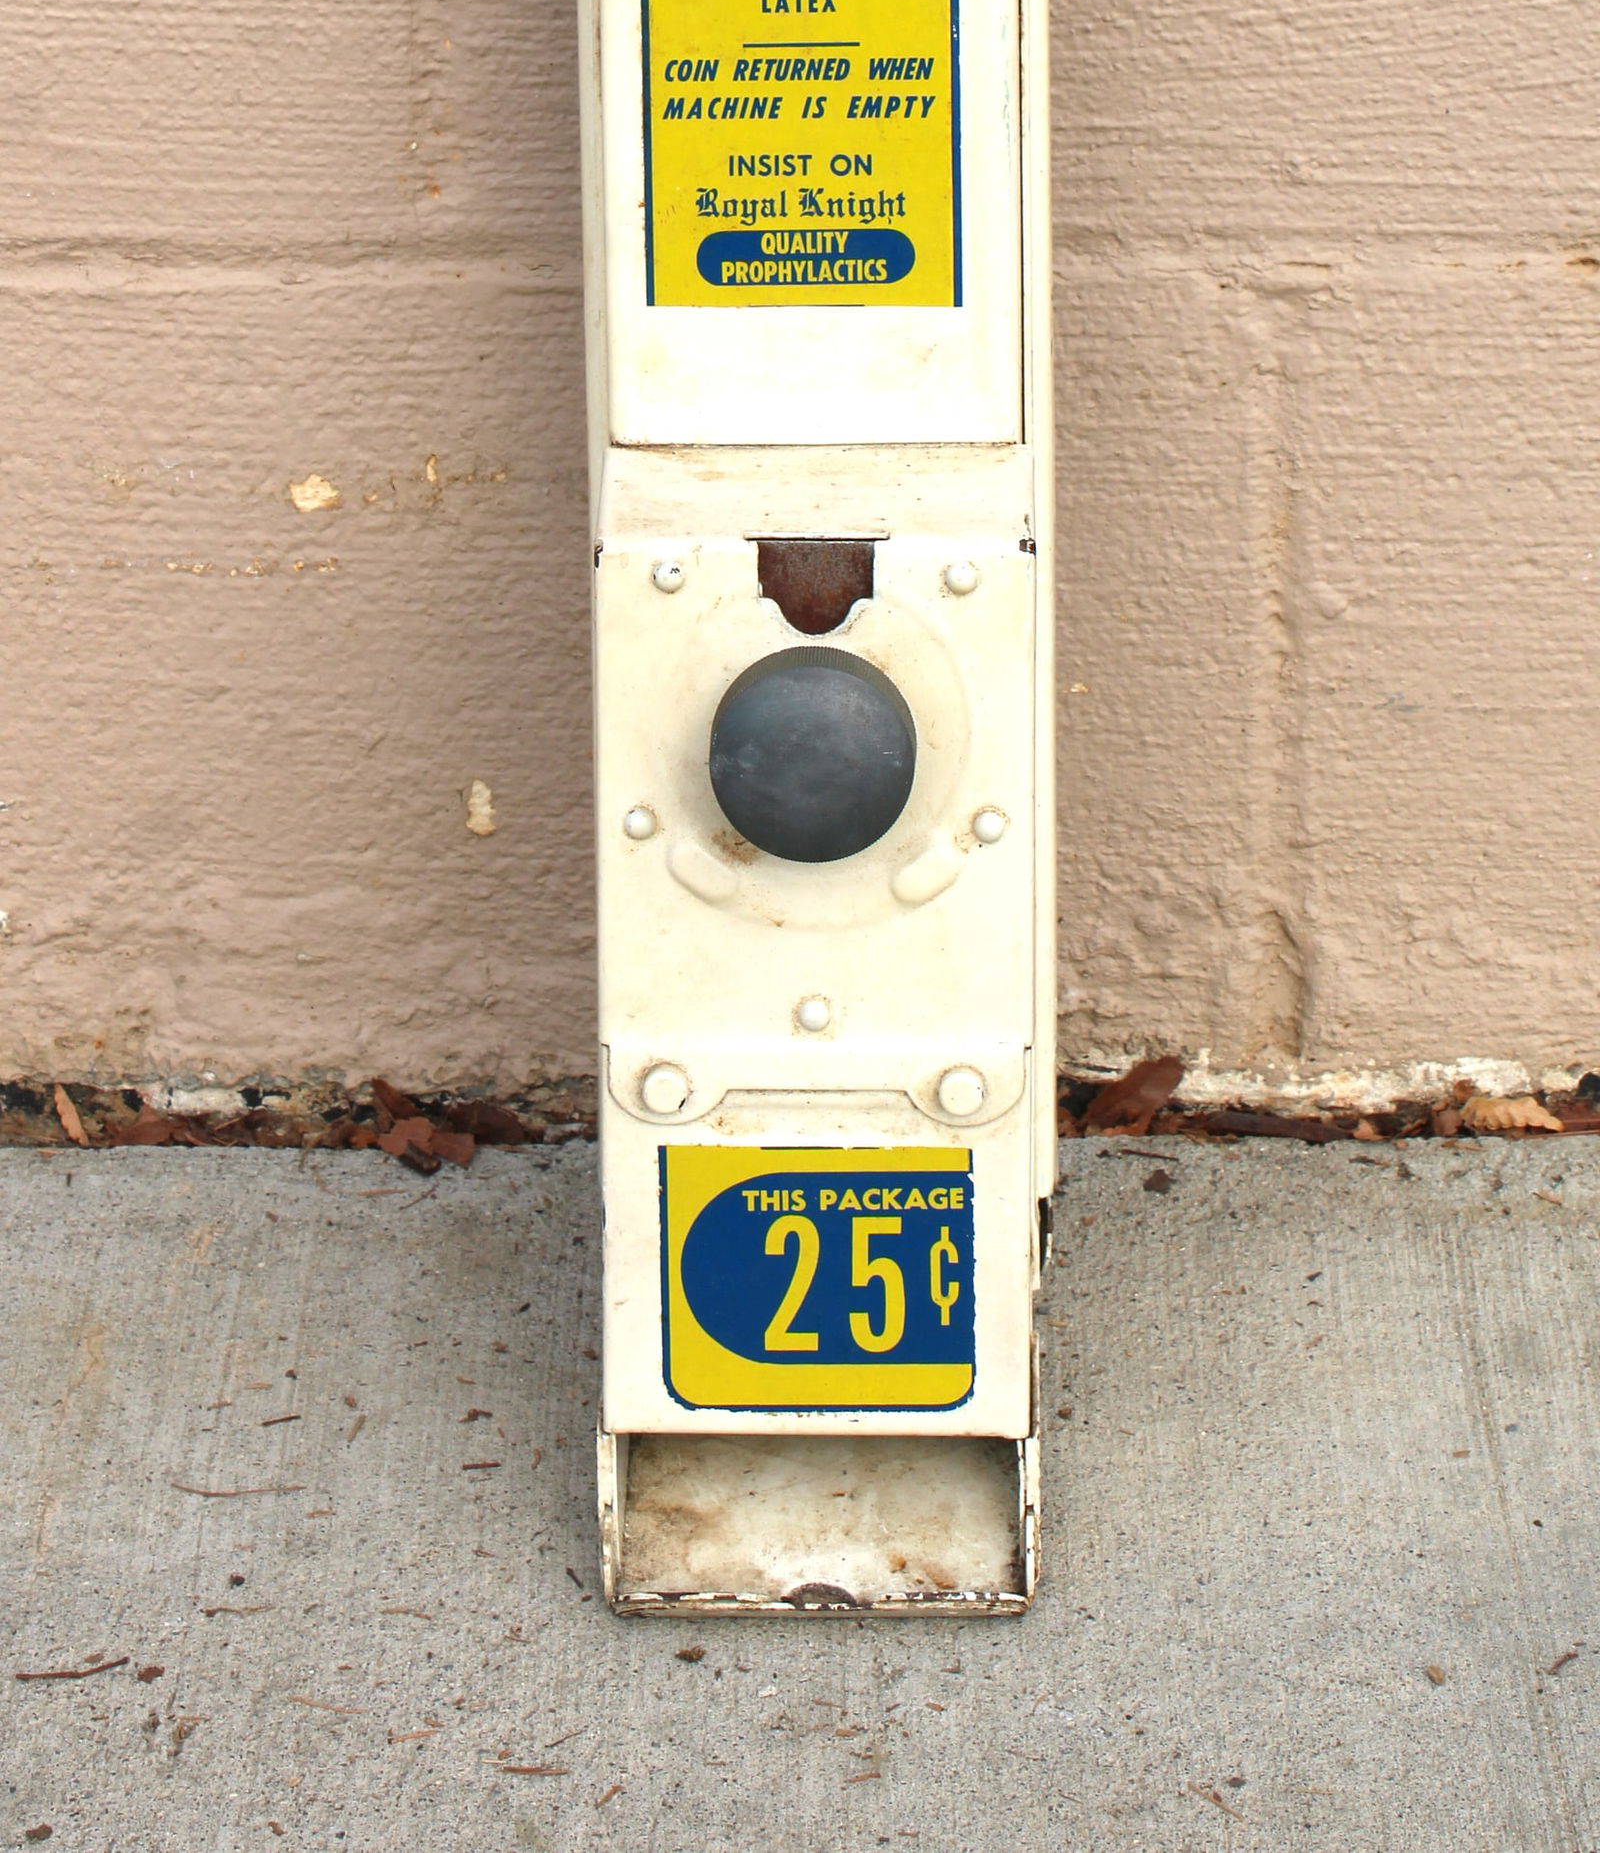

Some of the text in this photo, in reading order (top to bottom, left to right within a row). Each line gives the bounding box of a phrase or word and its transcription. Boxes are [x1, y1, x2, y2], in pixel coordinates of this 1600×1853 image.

[664, 57, 934, 82] COIN RETURNED WHEN
[662, 96, 936, 120] MACHINE IS EMPTY
[729, 154, 872, 177] INSIST ON
[696, 188, 906, 226] Royal Knight
[761, 231, 848, 255] QUALITY
[721, 259, 887, 284] PROPHYLACTICS
[742, 1188, 964, 1211] THIS PACKAGE
